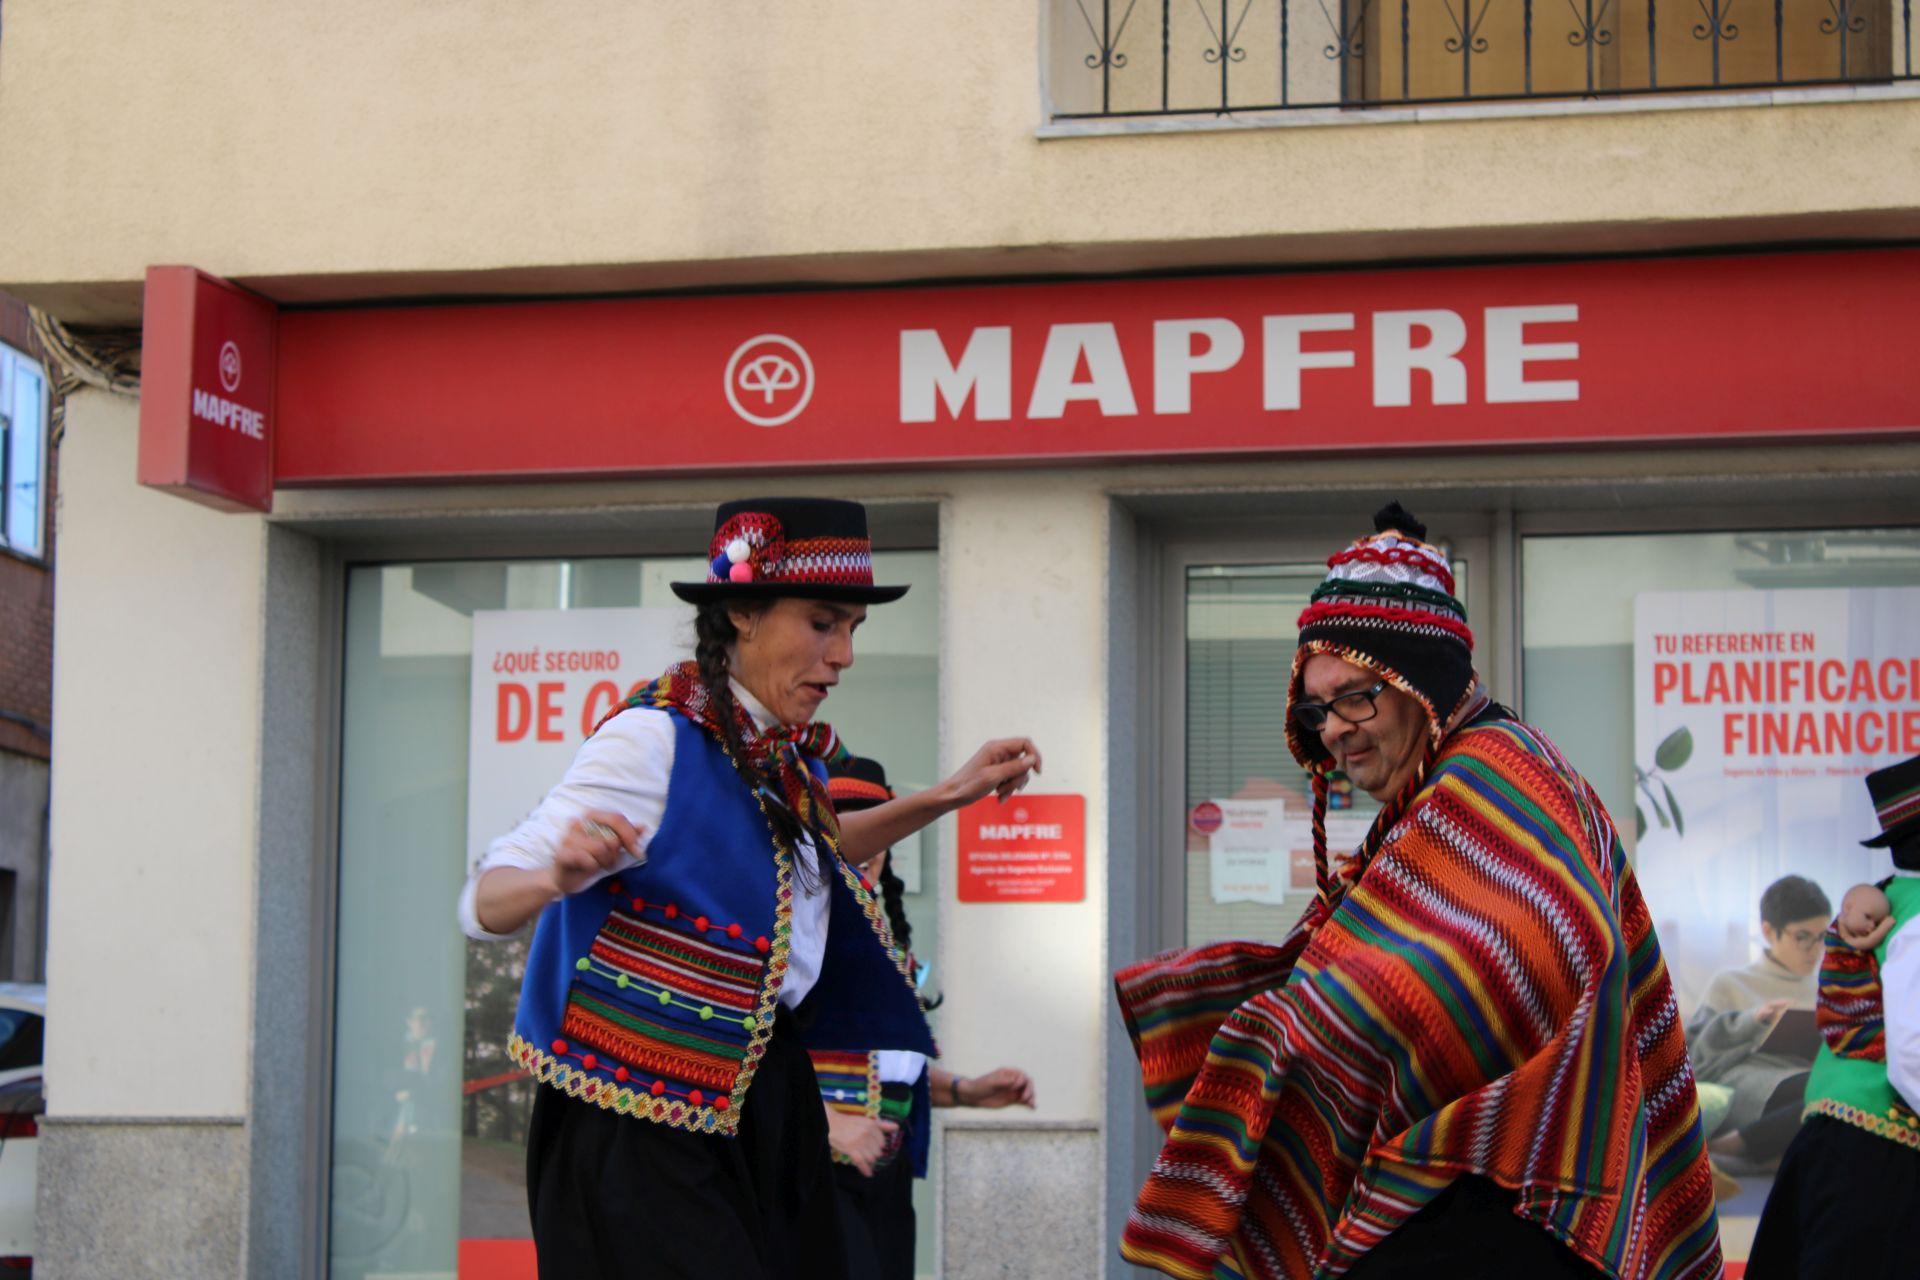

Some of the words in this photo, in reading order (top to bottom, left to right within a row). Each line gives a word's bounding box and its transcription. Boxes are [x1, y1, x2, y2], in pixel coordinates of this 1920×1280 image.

[900, 304, 1579, 423] MAPFRE
[194, 388, 264, 440] MAPFRE
[493, 647, 540, 674] ¿QUÉ
[545, 651, 620, 672] SEGURO
[1655, 635, 1677, 654] TU
[1682, 633, 1785, 654] REFERENTE
[1791, 632, 1815, 653] EN
[496, 682, 566, 742] DE
[979, 824, 1063, 840] MAPFRE
